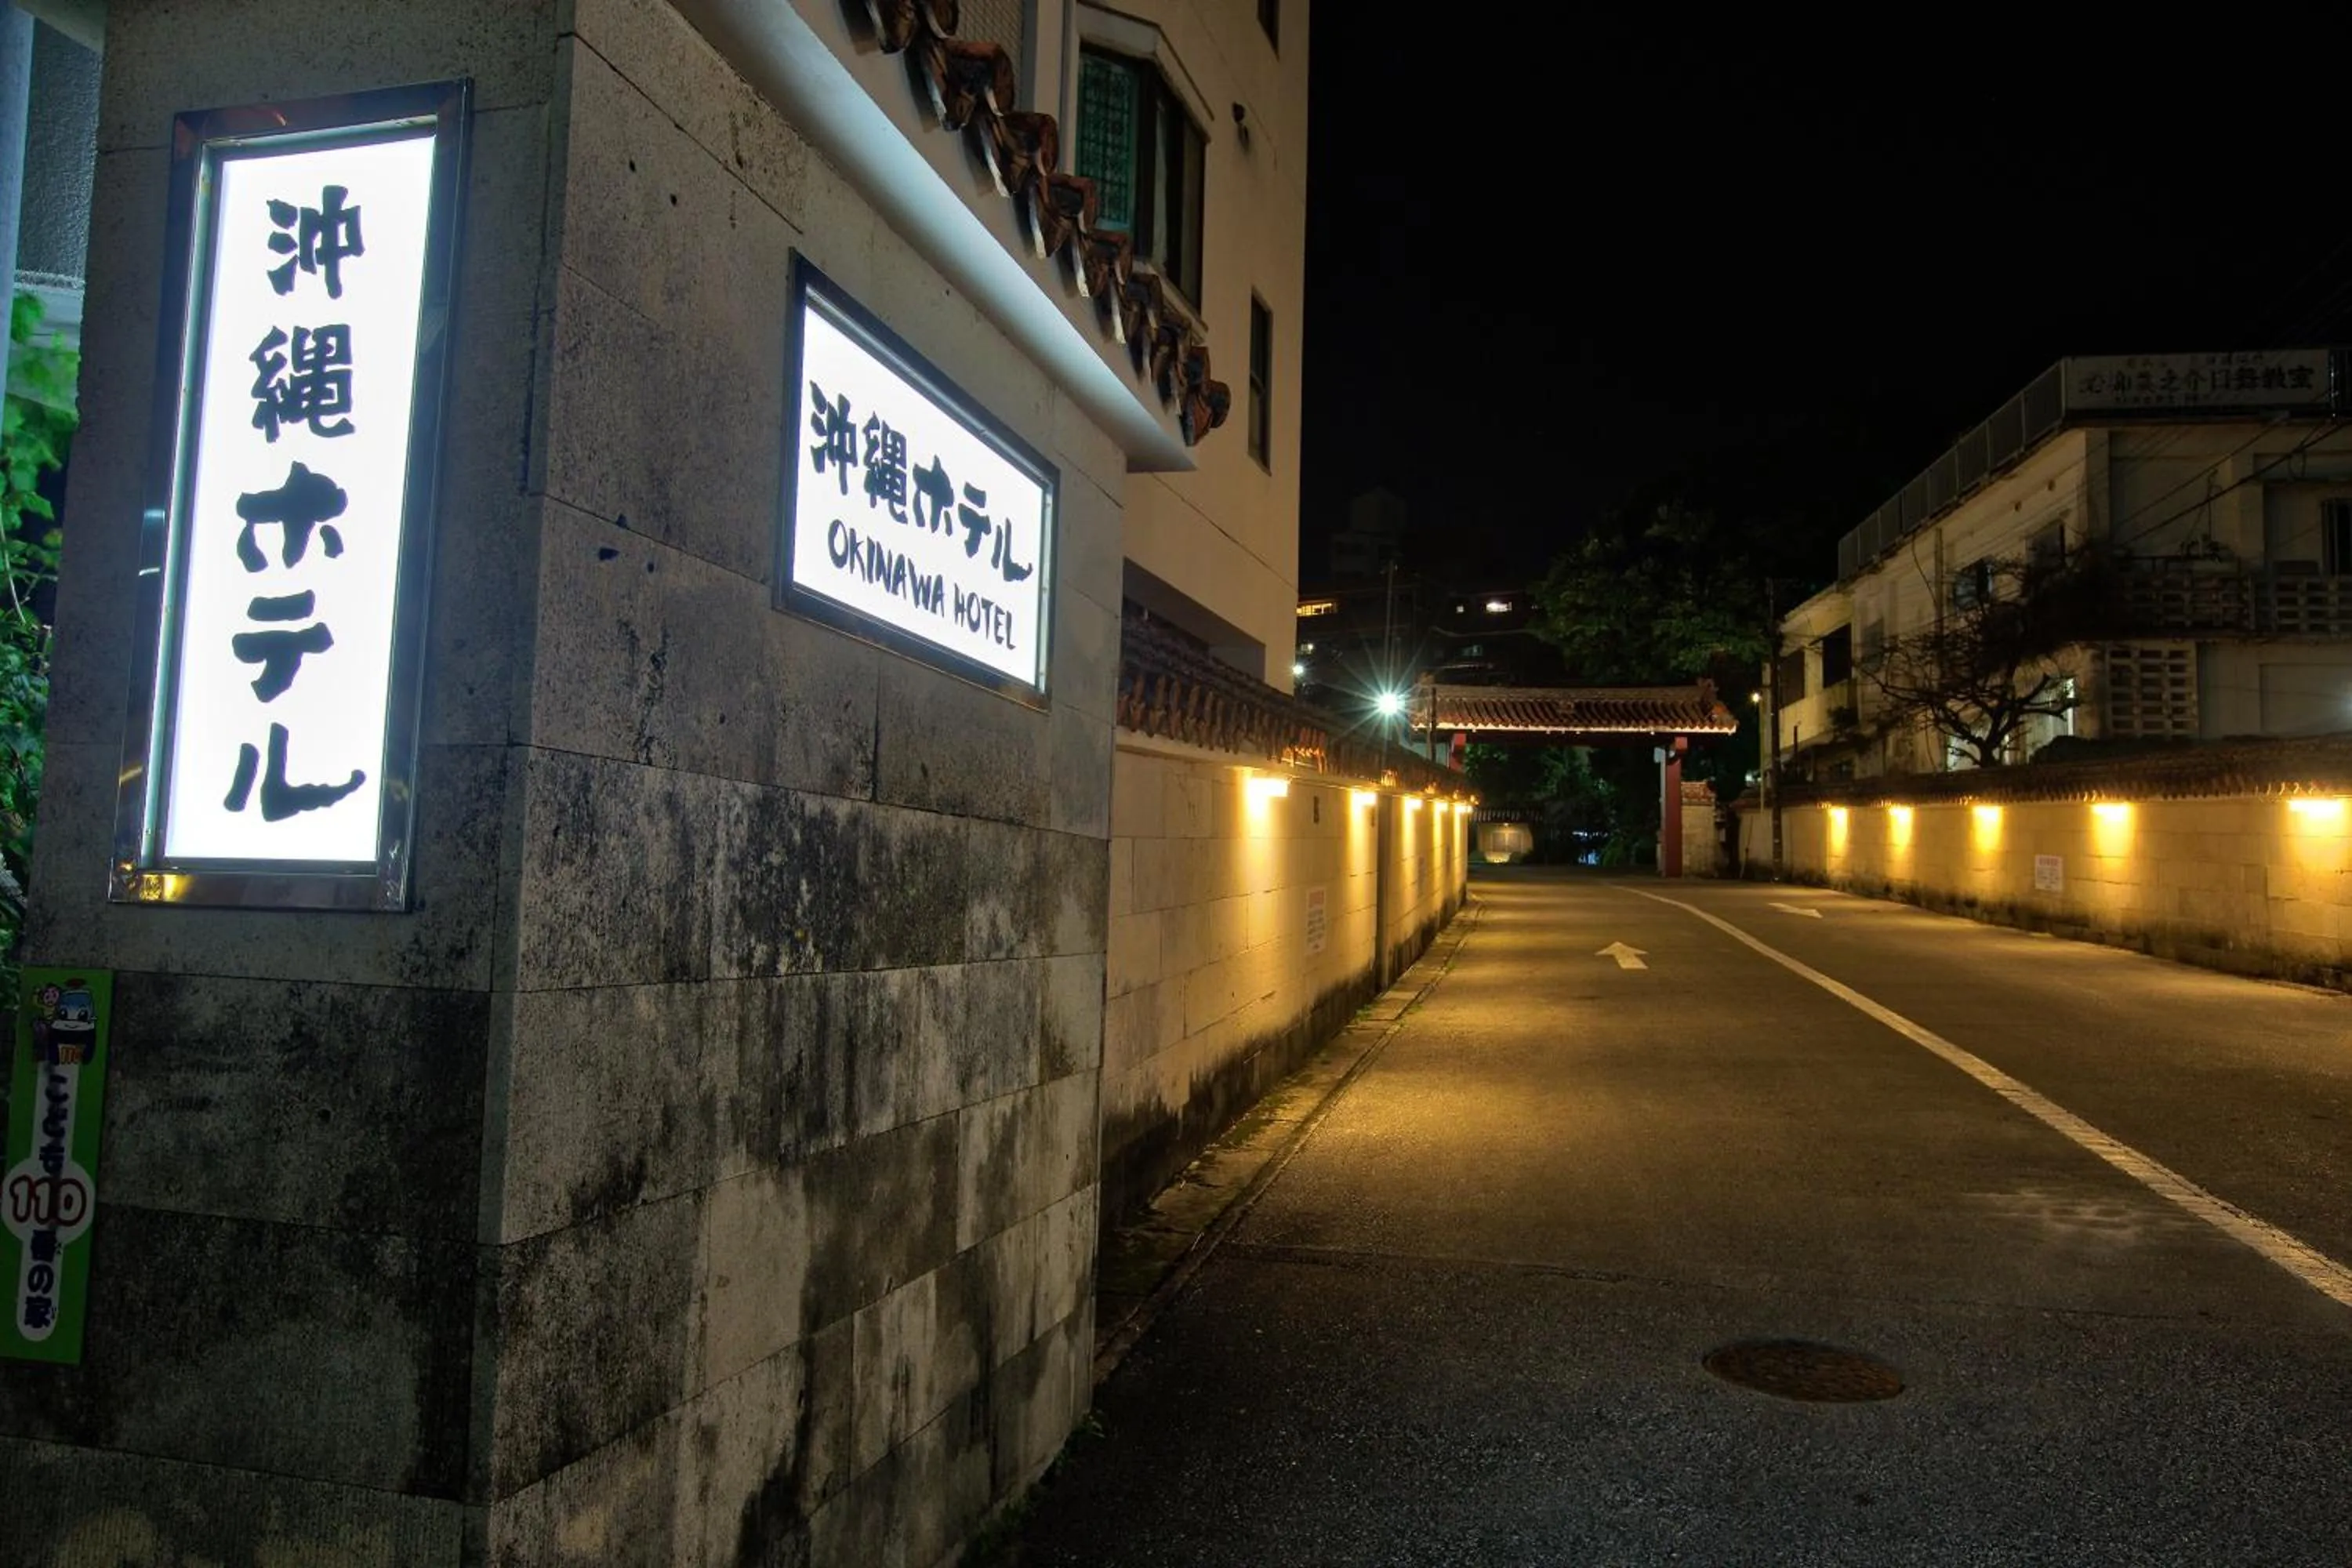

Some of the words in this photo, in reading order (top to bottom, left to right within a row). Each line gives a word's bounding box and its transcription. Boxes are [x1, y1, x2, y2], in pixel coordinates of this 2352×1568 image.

[225, 184, 365, 822] 沖縄ホテル
[810, 380, 1033, 583] 沖縄ホテル
[828, 519, 945, 618] OKINAWA
[954, 583, 1017, 650] HOTEL
[9, 1175, 86, 1227] 110
